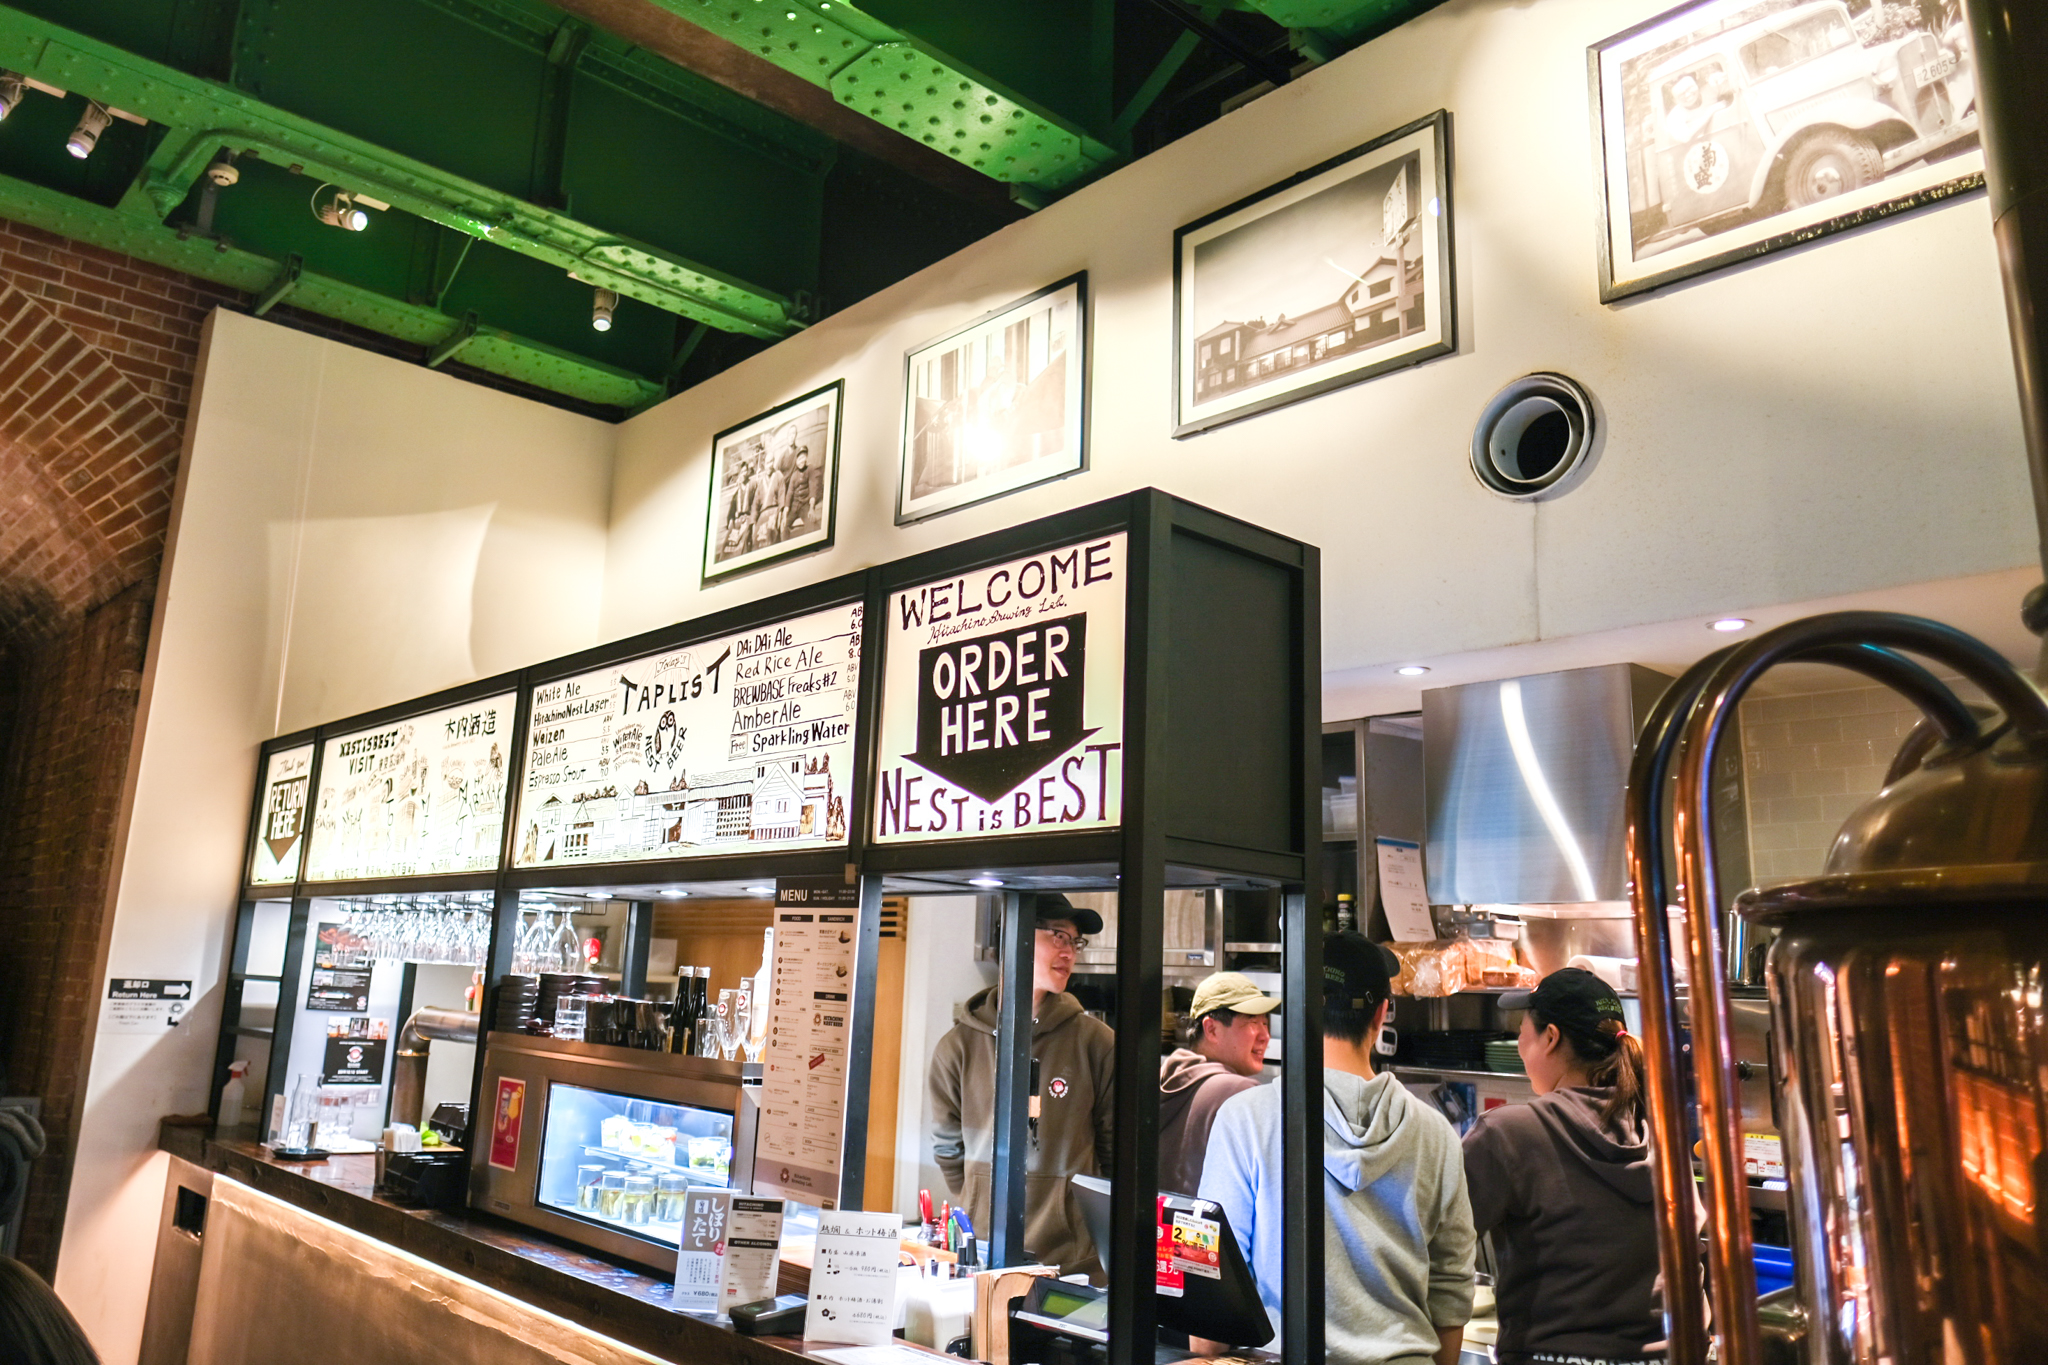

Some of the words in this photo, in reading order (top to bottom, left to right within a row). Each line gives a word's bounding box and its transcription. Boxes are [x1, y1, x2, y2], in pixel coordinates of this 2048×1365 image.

[900, 541, 1113, 630] WELCOME
[986, 604, 1032, 627] Brewing
[774, 627, 792, 647] Ale
[736, 660, 759, 682] Red
[764, 656, 792, 676] Rice
[796, 646, 823, 670] Ale
[933, 625, 1070, 699] ORDER
[537, 686, 561, 706] White
[565, 683, 581, 698] Ale
[619, 645, 731, 716] TAPLIST
[584, 698, 609, 714] Lager
[732, 707, 778, 733] Amber
[780, 701, 801, 724] Ale
[445, 709, 497, 741] 木内酒造
[533, 728, 565, 747] Weizen
[752, 727, 810, 752] Sparkling
[812, 721, 850, 742] Water
[941, 688, 1050, 757] HERE
[531, 750, 554, 768] Pale
[554, 747, 568, 762] Ale
[645, 735, 660, 773] NEST
[667, 727, 687, 770] BEER
[350, 754, 375, 775] VISIT
[529, 771, 560, 789] Espresso
[564, 765, 586, 783] Stout
[270, 779, 307, 814] RETURN
[879, 767, 969, 836] NEST
[979, 810, 1003, 831] is
[1014, 742, 1121, 829] BEST
[270, 808, 297, 840] HERE
[781, 889, 808, 901] MENU
[692, 1217, 707, 1247] たて
[709, 1197, 725, 1242] しぼり
[856, 1227, 898, 1238] ホット梅酒
[1174, 1227, 1182, 1240] 2
